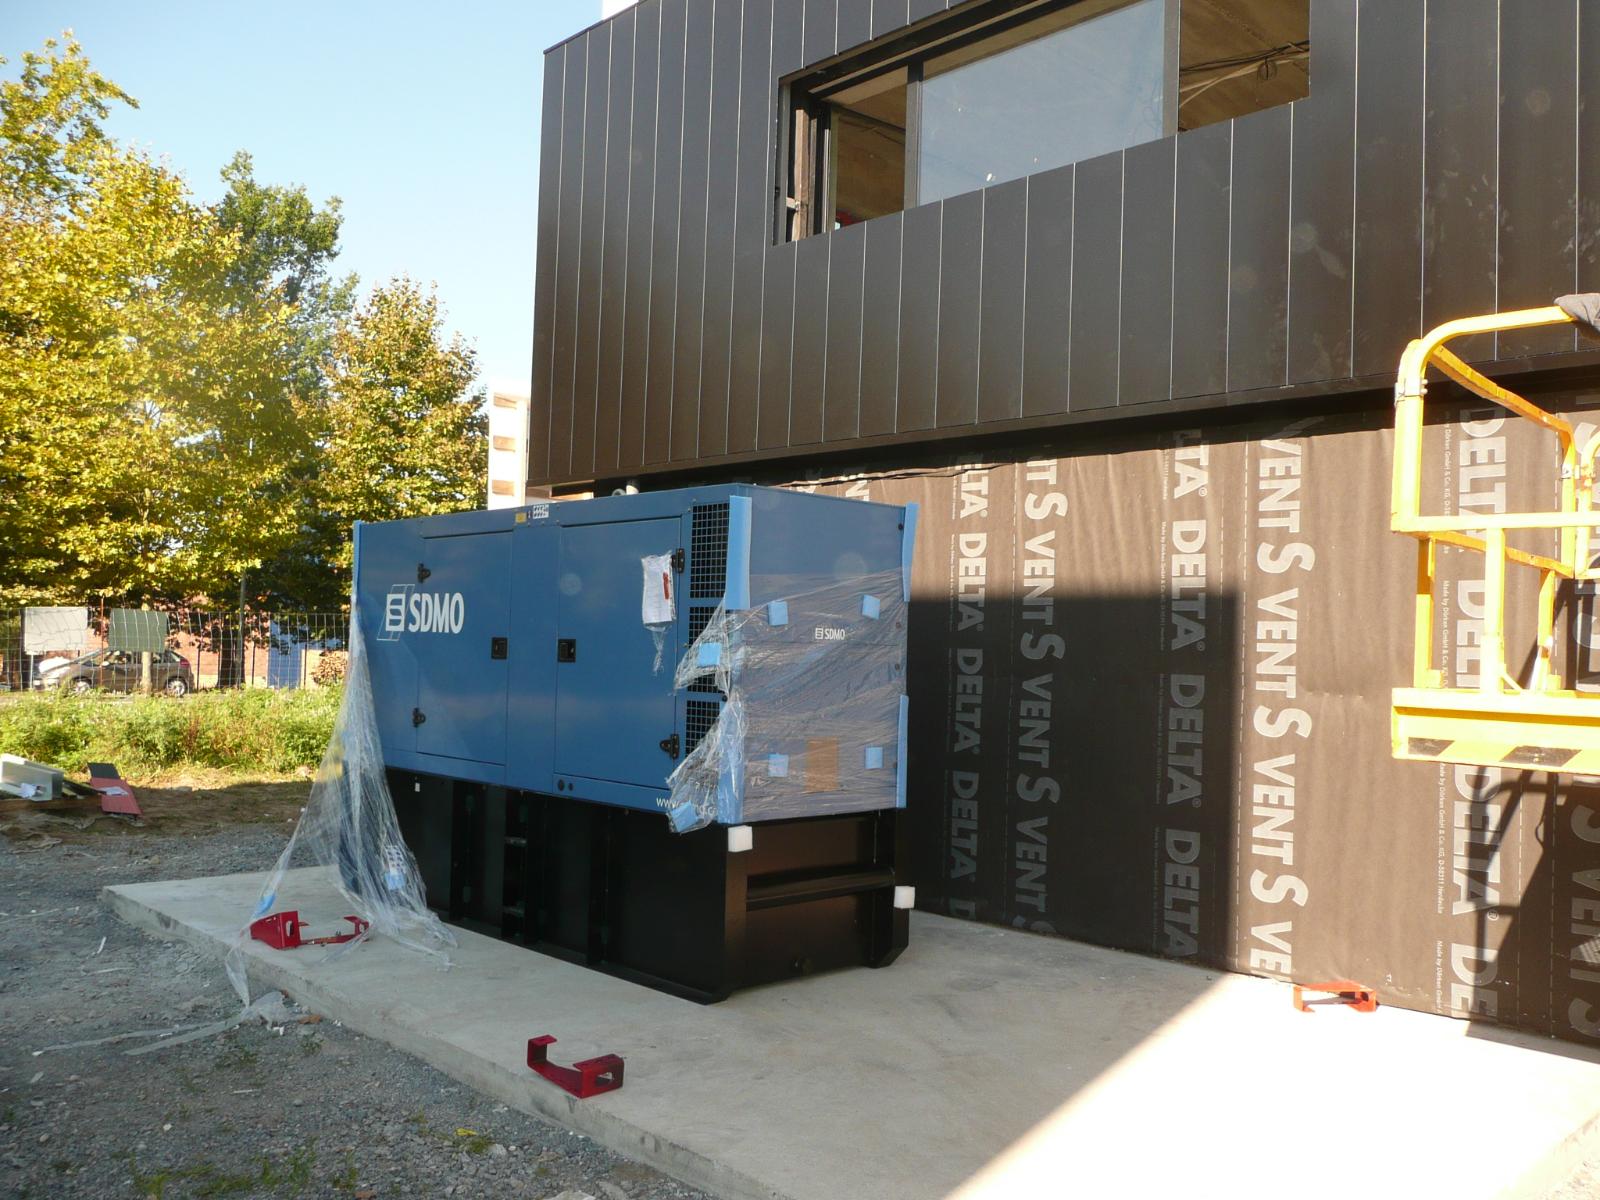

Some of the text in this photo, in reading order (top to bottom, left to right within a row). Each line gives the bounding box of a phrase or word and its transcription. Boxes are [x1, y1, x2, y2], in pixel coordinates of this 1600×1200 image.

[1024, 491, 1069, 520] S
[1256, 541, 1316, 574] S
[1022, 530, 1056, 626] VENT
[408, 592, 465, 634] SDMO
[824, 628, 846, 640] SDMO
[1020, 632, 1066, 660] S
[1255, 588, 1299, 699] VENT
[1018, 673, 1055, 768] VENT
[1253, 705, 1312, 738] S
[1016, 773, 1061, 803] S
[1251, 753, 1296, 865] VENT
[1015, 816, 1048, 912] VENT
[1250, 868, 1309, 907] S
[1250, 920, 1294, 977] VE
